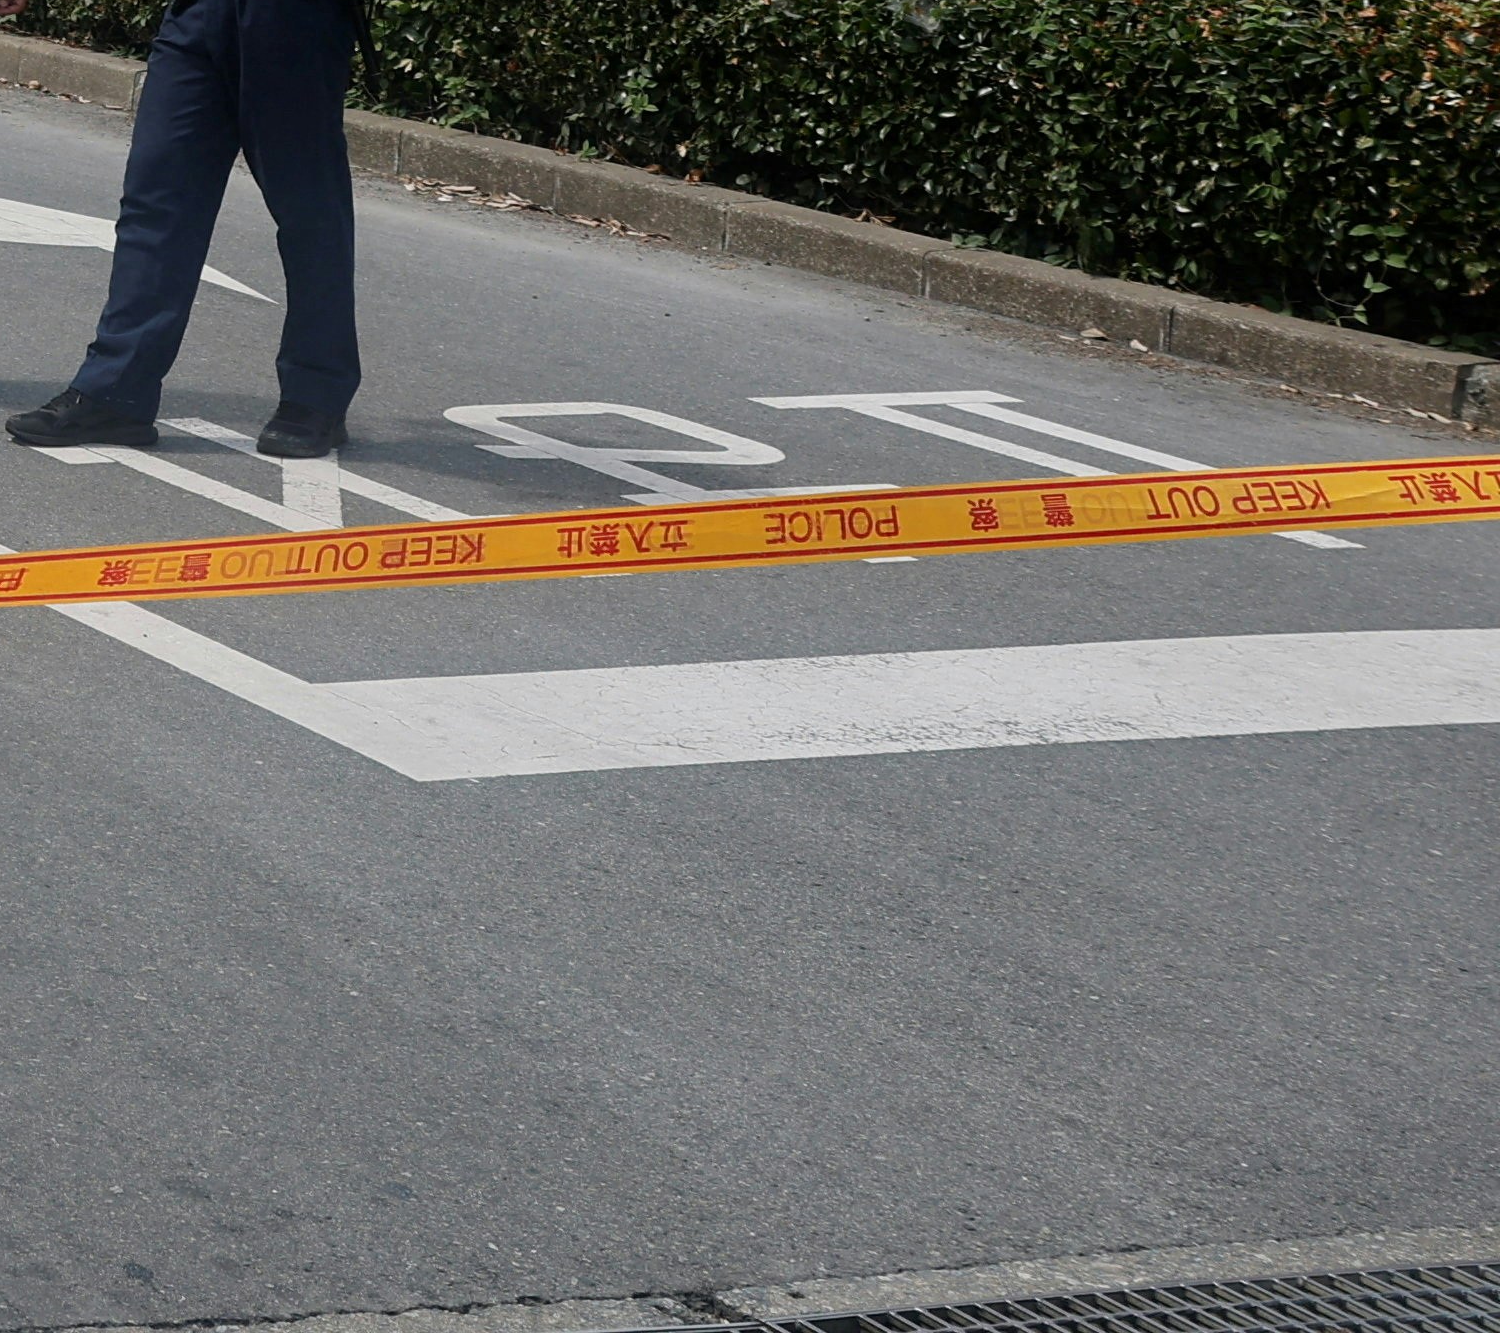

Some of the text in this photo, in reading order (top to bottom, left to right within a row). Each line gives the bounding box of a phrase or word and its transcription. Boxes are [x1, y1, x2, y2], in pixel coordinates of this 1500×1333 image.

[1142, 485, 1222, 523] OUT
[1230, 479, 1332, 517] KEEP
[555, 520, 691, 558] 立入禁止
[763, 506, 901, 546] POLICE
[288, 541, 370, 574] OUT
[379, 533, 485, 569] KEEP
